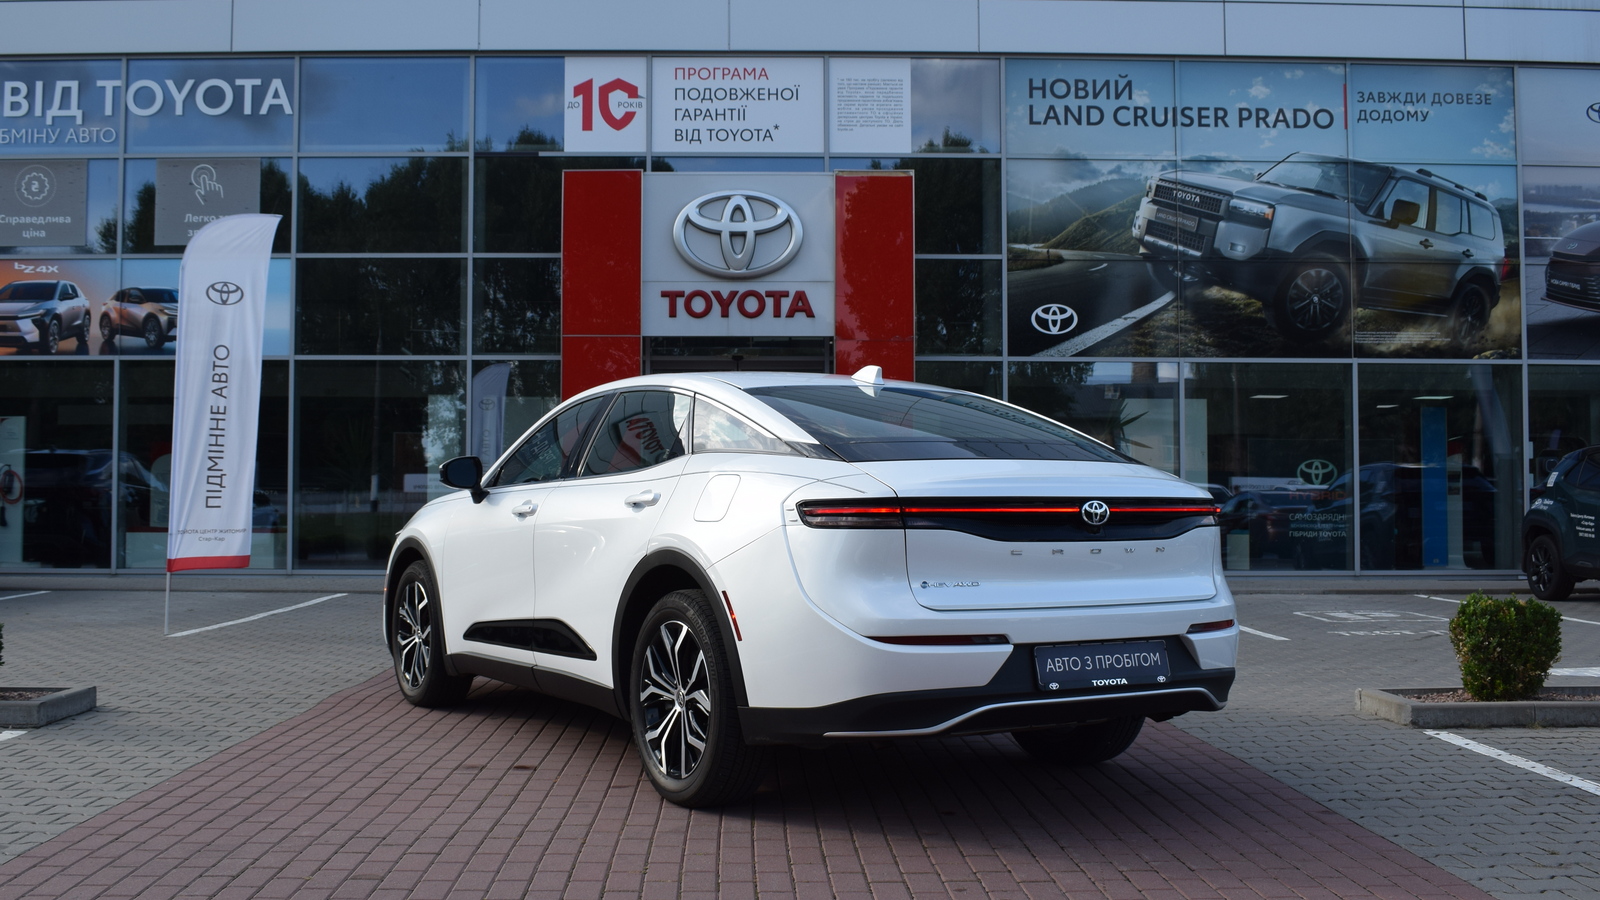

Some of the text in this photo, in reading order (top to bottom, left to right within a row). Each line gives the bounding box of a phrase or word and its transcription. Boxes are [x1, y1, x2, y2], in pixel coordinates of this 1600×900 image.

[674, 67, 769, 80] ПРОГРАМА
[674, 85, 801, 103] ПОДОВЖЕНОЇ
[1028, 74, 1133, 100] НОВИЙ
[3, 78, 294, 125] ВІД TOYOTA
[567, 102, 580, 110] ДО
[617, 101, 643, 109] РОКІВ
[1357, 91, 1492, 106] ЗАВЖДИ ДОВЕЗЕ
[674, 105, 748, 121] ГАРАНТІЇ
[1028, 104, 1335, 129] LAND CRUISER PRADO
[1357, 109, 1430, 124] ДОДОМУ
[65, 127, 117, 143] АВТО
[674, 128, 702, 144] ВІД
[1173, 191, 1200, 202] TOYOTA
[0, 214, 71, 225] Справедлива
[22, 228, 46, 238] ціна
[660, 289, 816, 319] TOYOTA
[205, 344, 230, 509] ПІДМІННЕ АВТО
[1289, 513, 1347, 521] САМОЗАРЯДНІ
[1010, 546, 1165, 556] CROWN
[1046, 652, 1162, 673] АВТО З ПРОБІГОМ
[1091, 677, 1128, 687] TOYOTA
